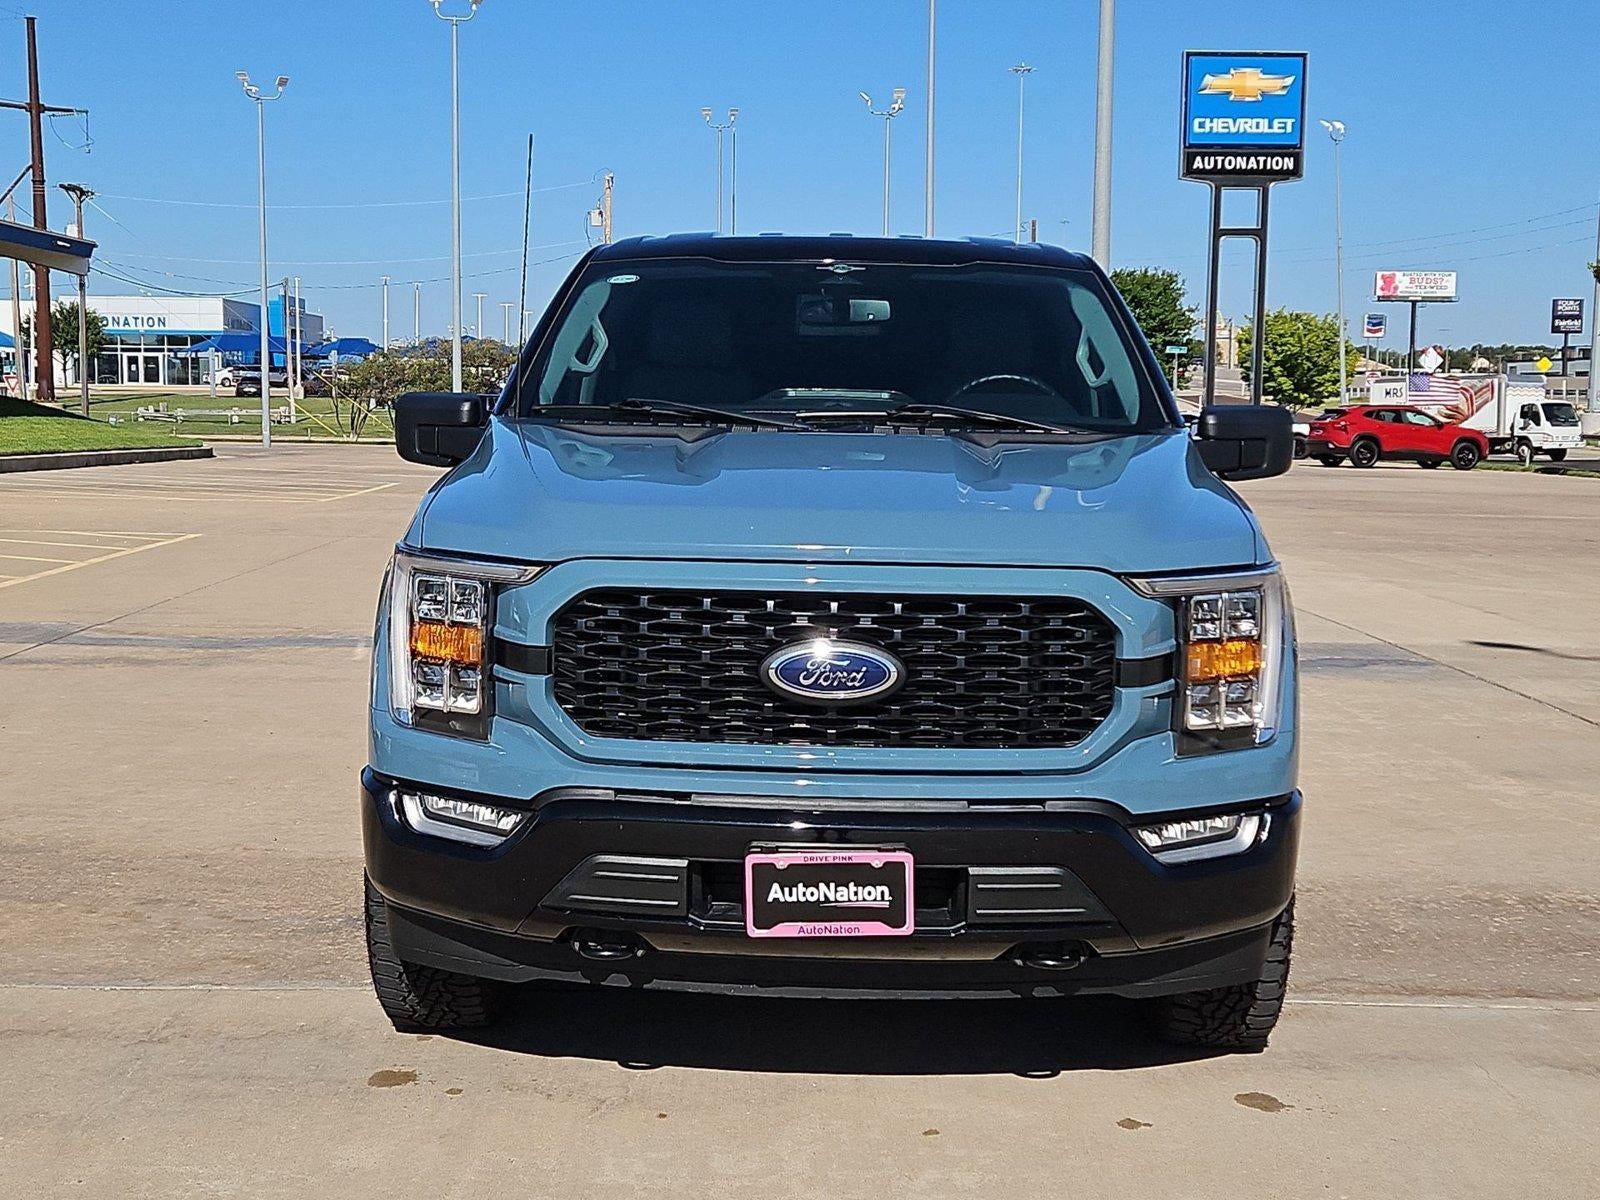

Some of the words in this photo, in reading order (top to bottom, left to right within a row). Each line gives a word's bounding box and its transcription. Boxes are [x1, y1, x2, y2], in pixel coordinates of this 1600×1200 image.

[1193, 117, 1296, 134] CHEVROLET
[1192, 155, 1294, 170] AUTONATION
[1409, 277, 1445, 285] BUDS?
[799, 658, 866, 687] Ford
[803, 855, 830, 863] DRIVE
[832, 855, 854, 863] PINK
[797, 925, 860, 936] AutoNation
